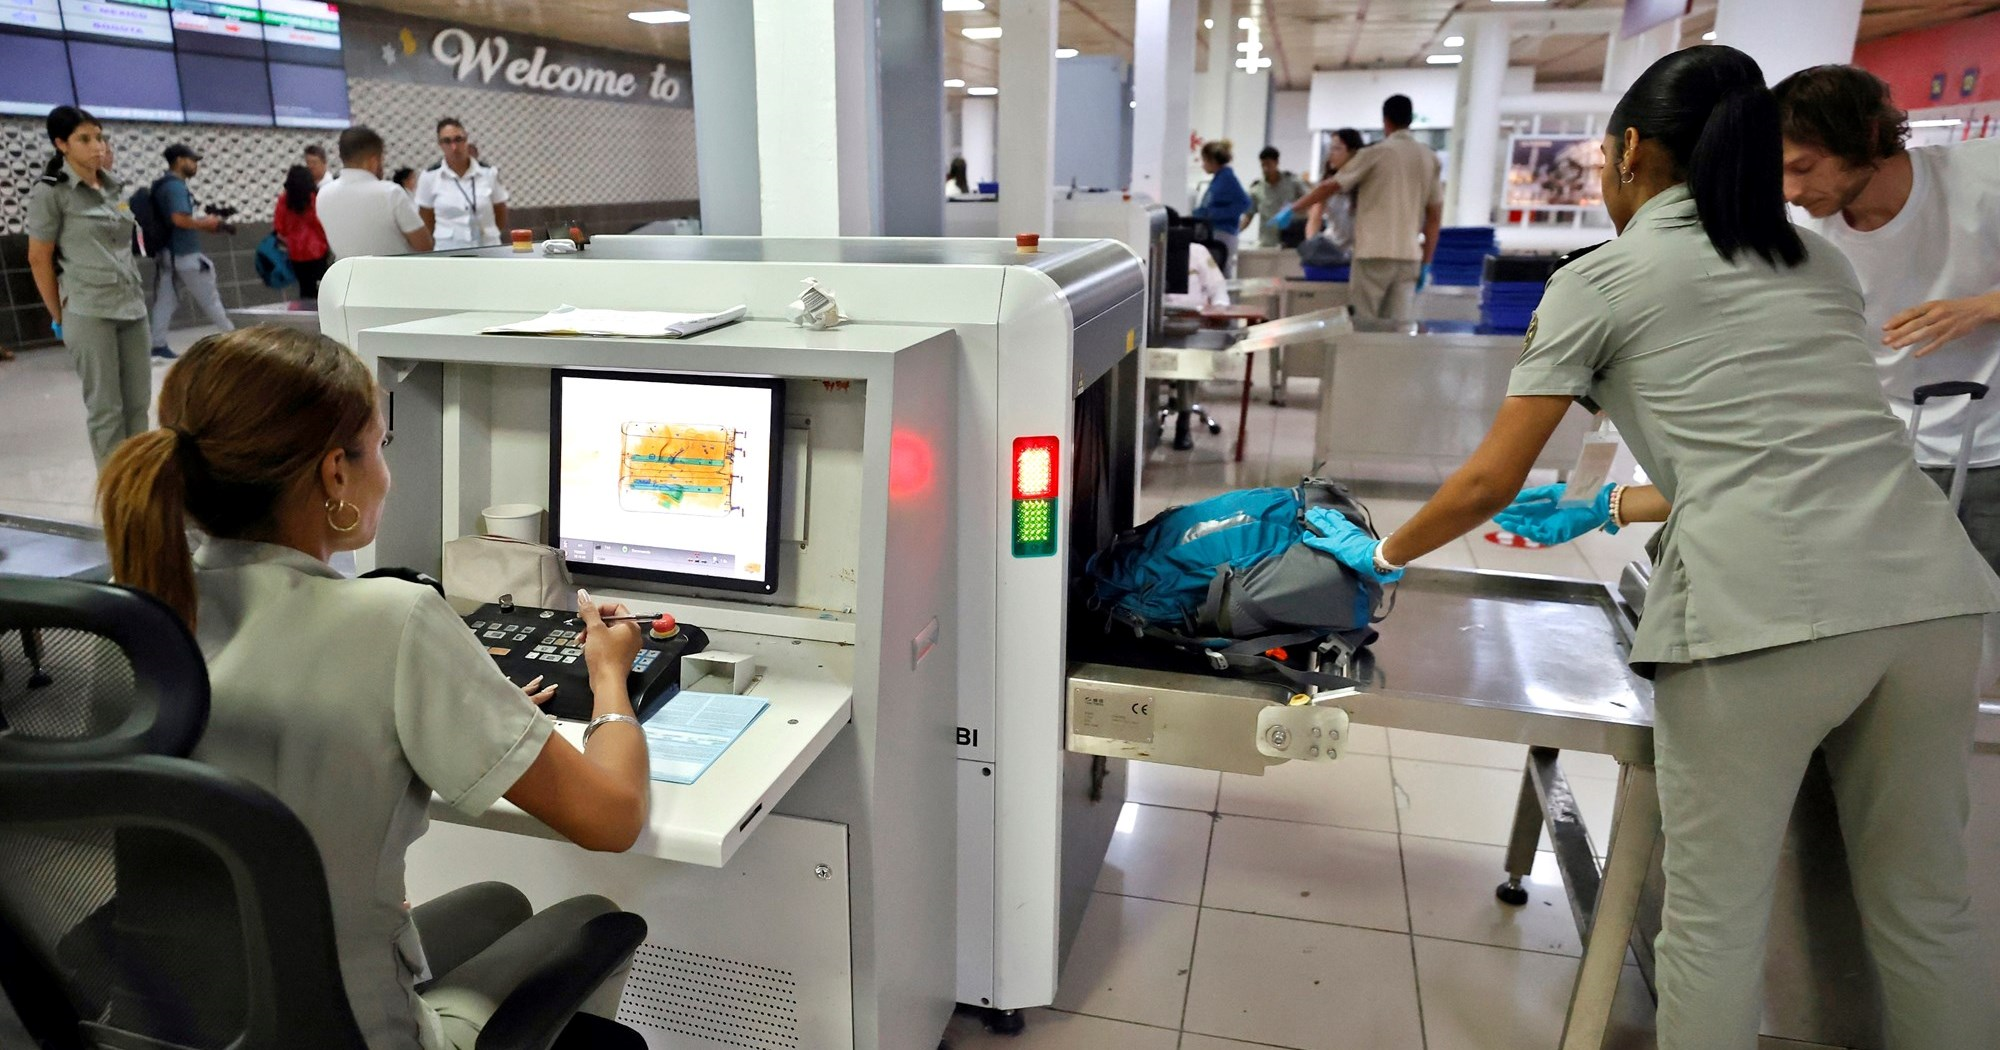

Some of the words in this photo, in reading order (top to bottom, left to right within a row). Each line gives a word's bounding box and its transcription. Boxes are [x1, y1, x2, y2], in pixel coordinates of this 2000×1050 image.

[432, 28, 636, 97] Welcome
[649, 63, 680, 101] to
[1131, 703, 1149, 716] CE
[956, 726, 978, 748] BI
